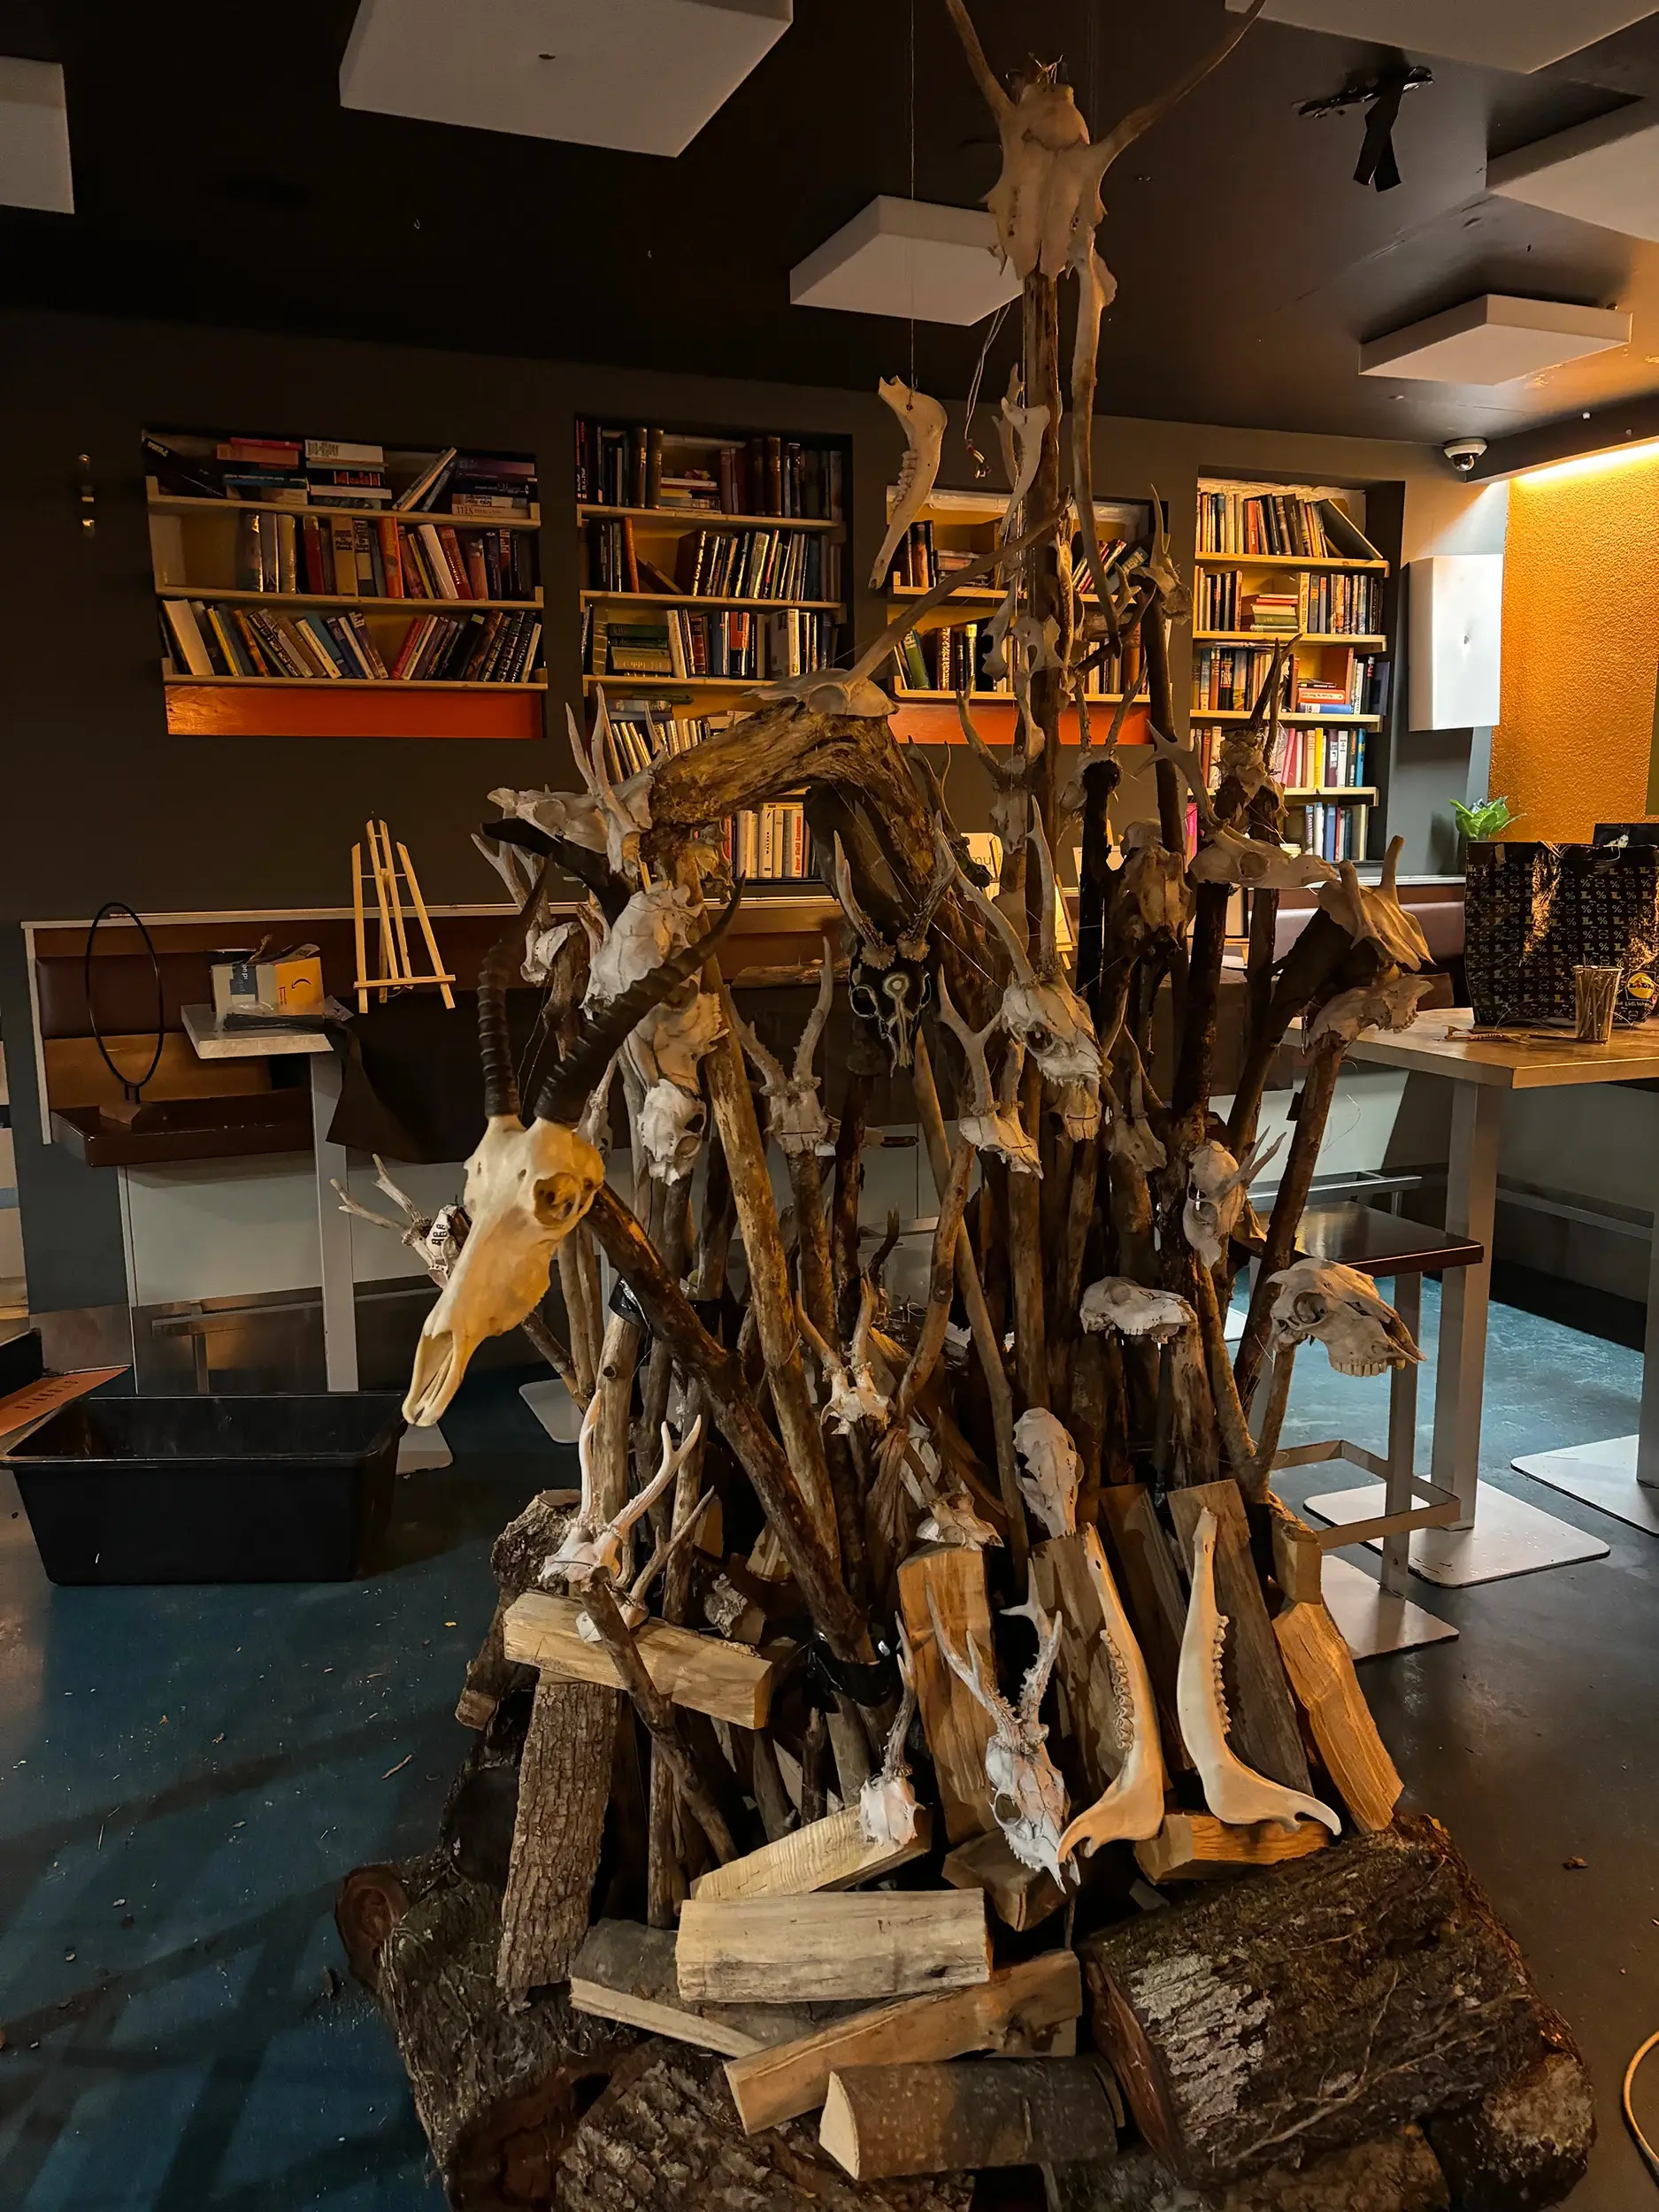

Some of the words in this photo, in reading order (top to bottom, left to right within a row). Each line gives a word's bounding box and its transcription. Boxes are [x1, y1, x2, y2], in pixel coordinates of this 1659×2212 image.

[1580, 879, 1590, 887] %
[1609, 879, 1620, 888] %
[1640, 879, 1651, 887] %
[1494, 889, 1505, 898] L
[1509, 889, 1519, 898] %
[1596, 890, 1606, 899] %
[1626, 891, 1636, 900] %
[1495, 904, 1504, 913] %
[1494, 917, 1504, 926] L
[1583, 931, 1593, 940] %
[1613, 931, 1624, 940] %
[1583, 942, 1594, 951] L
[1599, 942, 1609, 951] %
[1613, 942, 1626, 951] L
[1554, 981, 1564, 990] %
